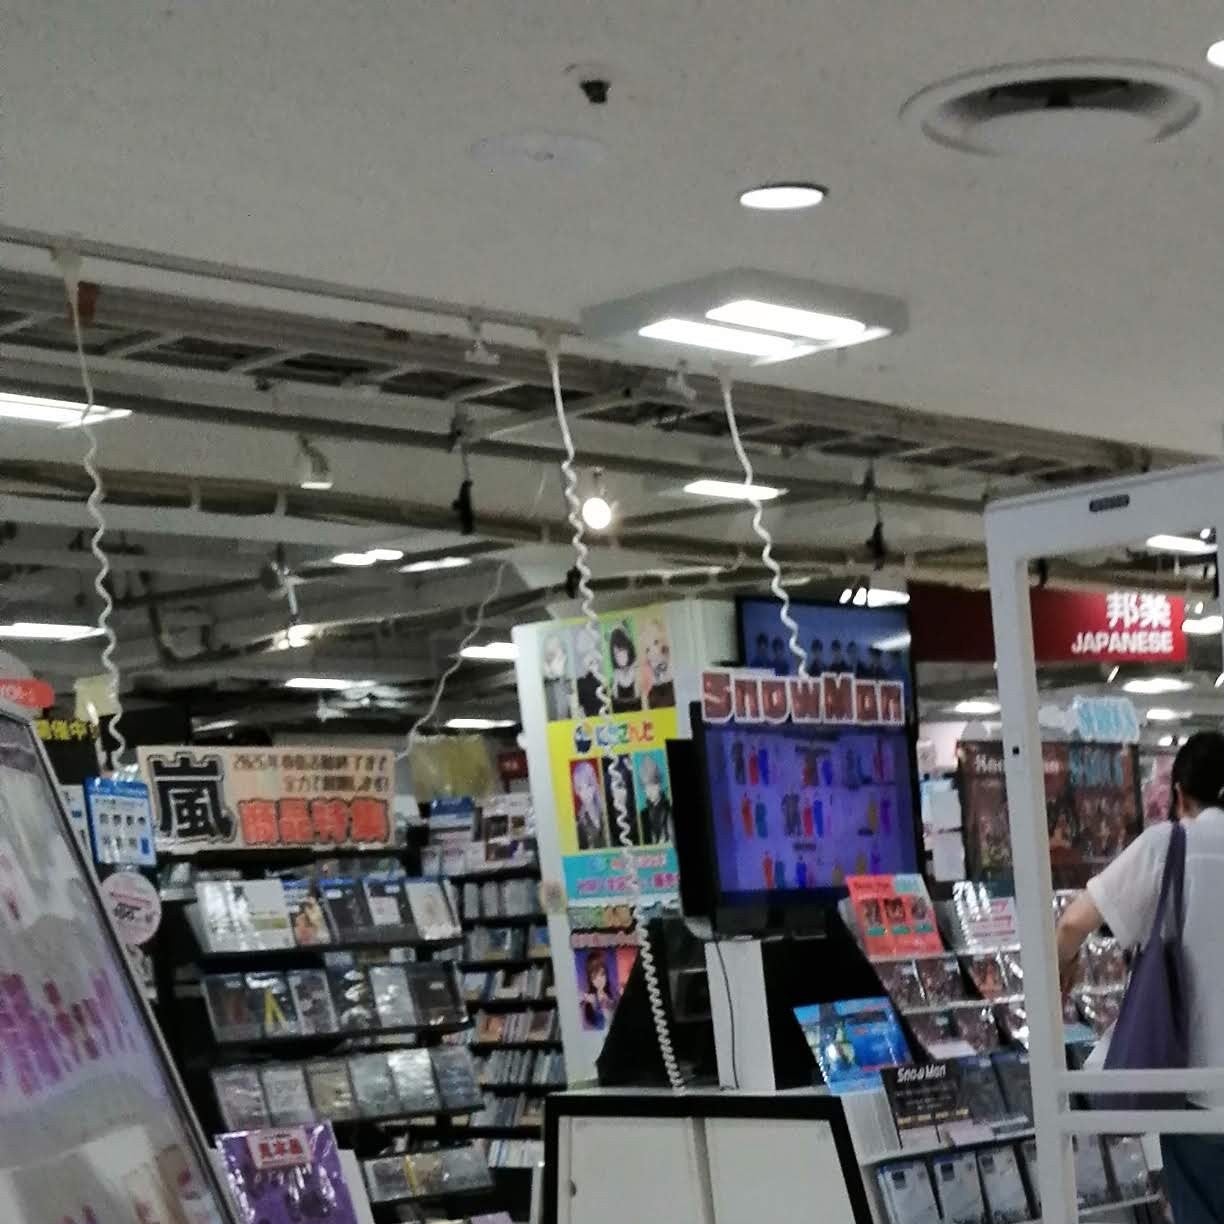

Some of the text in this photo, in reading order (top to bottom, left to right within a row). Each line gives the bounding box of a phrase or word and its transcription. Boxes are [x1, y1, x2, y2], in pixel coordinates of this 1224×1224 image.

[1107, 591, 1172, 629] 邦楽
[1072, 631, 1174, 655] JAPANESE
[149, 752, 237, 841] 嵐
